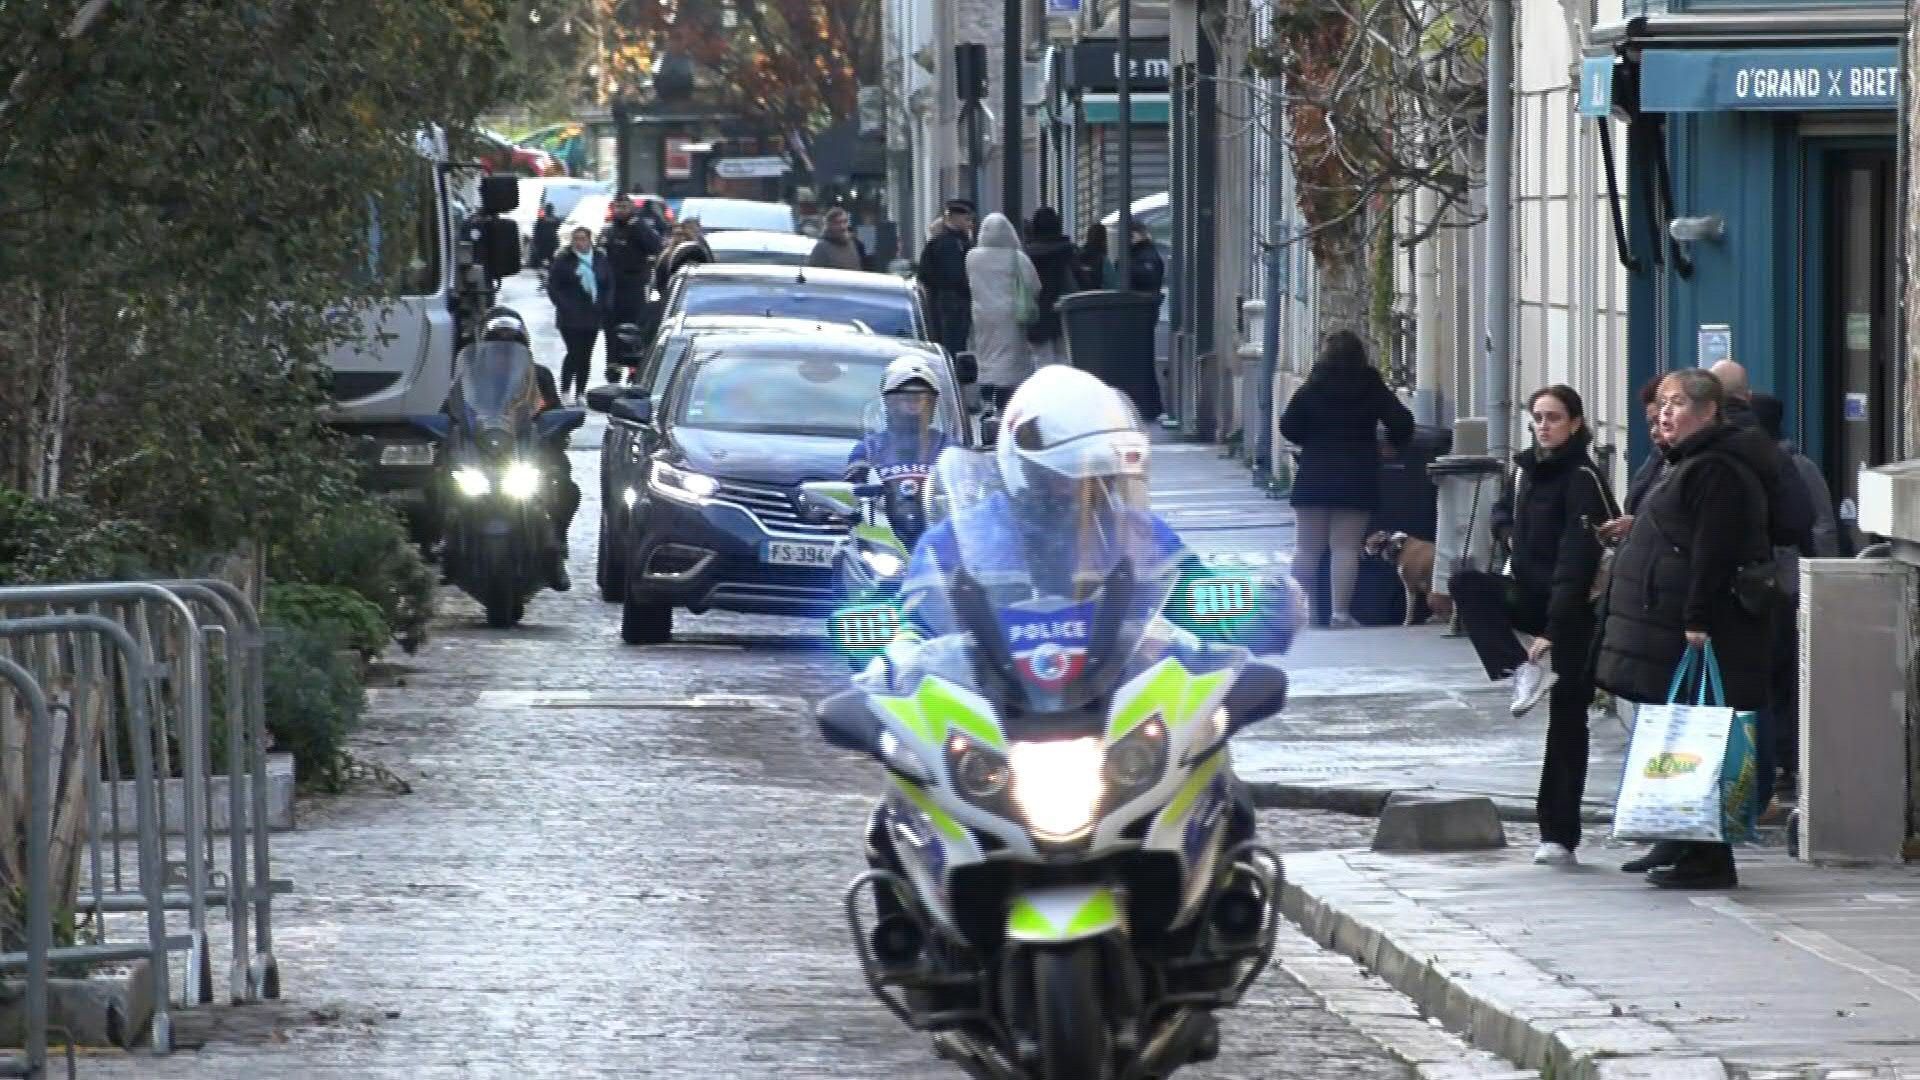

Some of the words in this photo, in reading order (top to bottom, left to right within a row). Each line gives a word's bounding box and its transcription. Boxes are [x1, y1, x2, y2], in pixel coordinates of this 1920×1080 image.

[1736, 68, 1821, 98] O'GRAND
[1827, 69, 1843, 96] X
[1850, 67, 1899, 97] BRET
[771, 544, 831, 563] FS-394
[1008, 621, 1087, 642] POLICE
